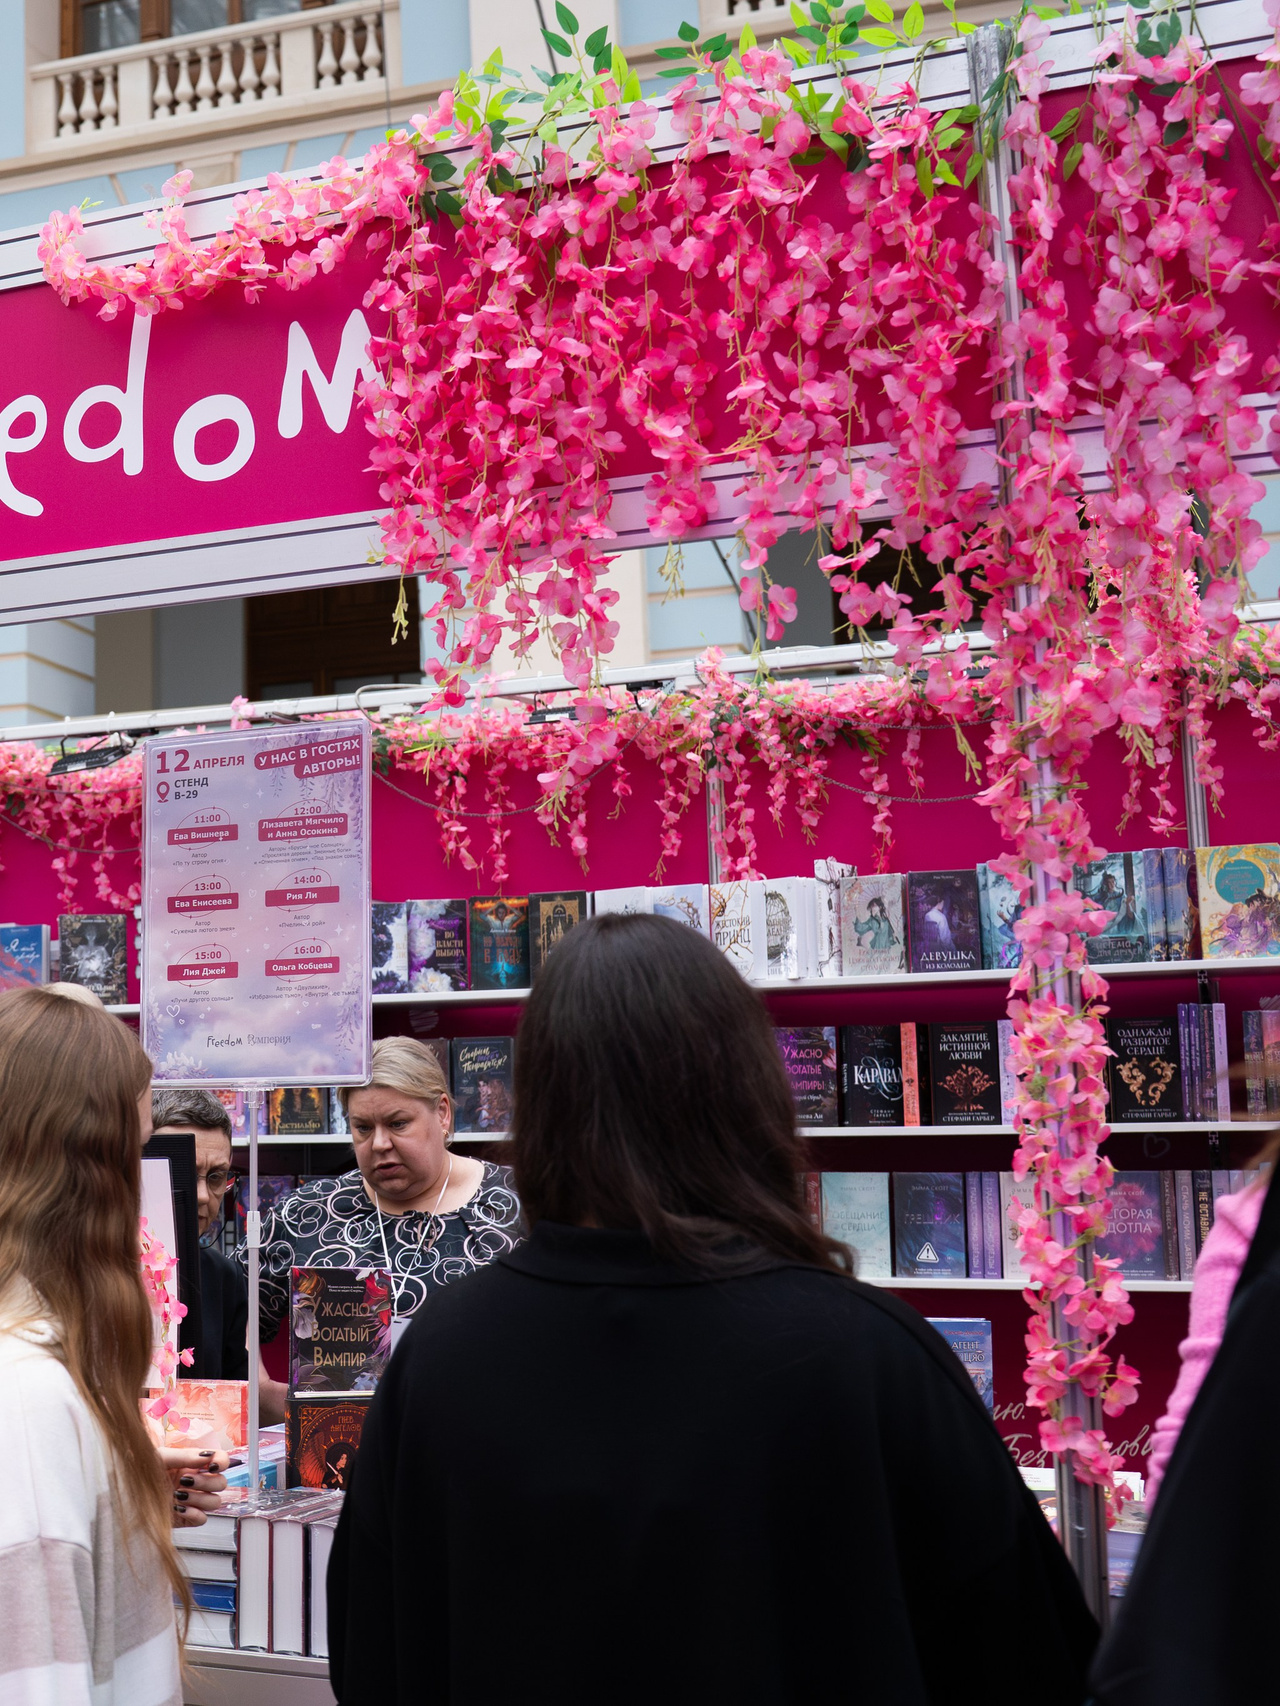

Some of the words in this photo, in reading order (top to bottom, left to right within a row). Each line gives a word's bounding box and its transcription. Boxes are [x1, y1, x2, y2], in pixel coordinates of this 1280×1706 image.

[259, 756, 268, 766] У
[271, 751, 296, 764] НАС
[299, 749, 308, 759] В
[311, 739, 360, 757] ГОСТЯХ
[156, 749, 190, 774] 12
[193, 755, 245, 770] АПРЕЛЯ
[302, 754, 360, 775] АВТОРЫ!
[174, 777, 209, 788] СТЕНД
[294, 806, 322, 815] 12:00
[194, 814, 221, 824] 11:00
[262, 819, 303, 830] Лизавета
[305, 816, 344, 827] Мягчило
[174, 832, 189, 841] Ева
[276, 829, 298, 838] Анна
[300, 826, 338, 837] Осокина
[294, 875, 322, 884] 14:00
[194, 882, 221, 891] 13:00
[286, 892, 303, 900] Рия
[305, 891, 318, 899] Ли
[175, 899, 190, 908] Ева
[192, 897, 232, 907] Енисеева
[715, 928, 751, 946] ПРИНЦ
[436, 939, 463, 948] ВЛАСТИ
[195, 951, 221, 960] 15:00
[294, 946, 322, 955] 16:00
[435, 948, 465, 957] ВЫБОРА
[920, 950, 976, 961] ДЕВУШКА
[182, 967, 199, 976] Лия
[201, 965, 226, 976] Джей
[272, 963, 296, 973] Ольга
[298, 961, 333, 971] Кобцева
[1117, 1027, 1171, 1037] ОДНАЖДЫ
[940, 1033, 988, 1042] ЗАКЛЯТИЕ
[1120, 1037, 1170, 1046] РАЗБИТОЕ
[939, 1042, 990, 1052] ИСТИННОЙ
[1127, 1046, 1165, 1056] СЕРДЦЕ
[949, 1051, 982, 1060] ЛЮБВИ
[1199, 1191, 1207, 1202] НЕ
[1104, 1208, 1153, 1220] СГОРАЯ
[841, 1222, 877, 1232] СЕРДЦА
[1106, 1222, 1153, 1234] ДОТЛА
[311, 1321, 369, 1342] БОГАТЫЙ
[951, 1341, 980, 1350] АГЕНТ
[313, 1346, 367, 1367] ВАМПИР
[338, 1416, 354, 1424] ГНЕВ
